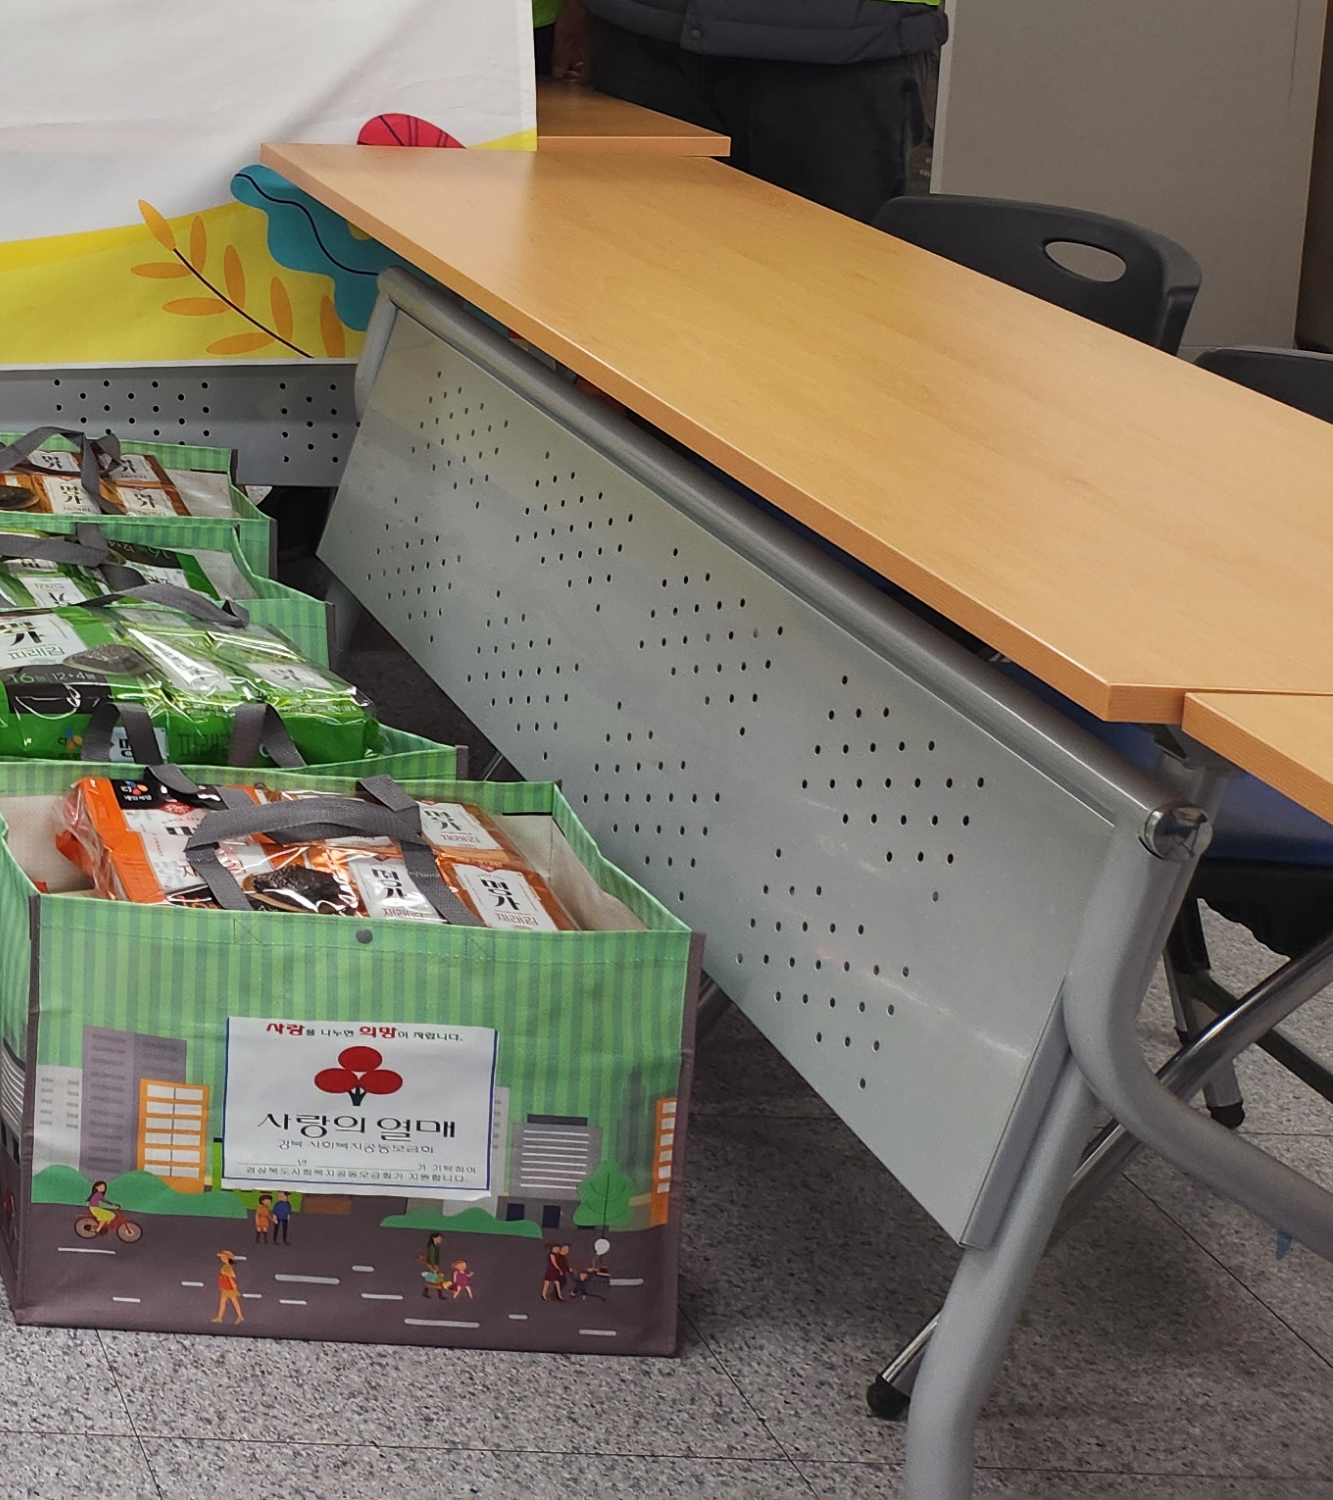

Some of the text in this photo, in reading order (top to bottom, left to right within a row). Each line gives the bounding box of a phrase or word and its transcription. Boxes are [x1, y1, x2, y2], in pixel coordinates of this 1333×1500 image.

[480, 878, 520, 911] 명가
[359, 1026, 408, 1039] 희망이
[257, 1113, 455, 1142] 사랑의 열매
